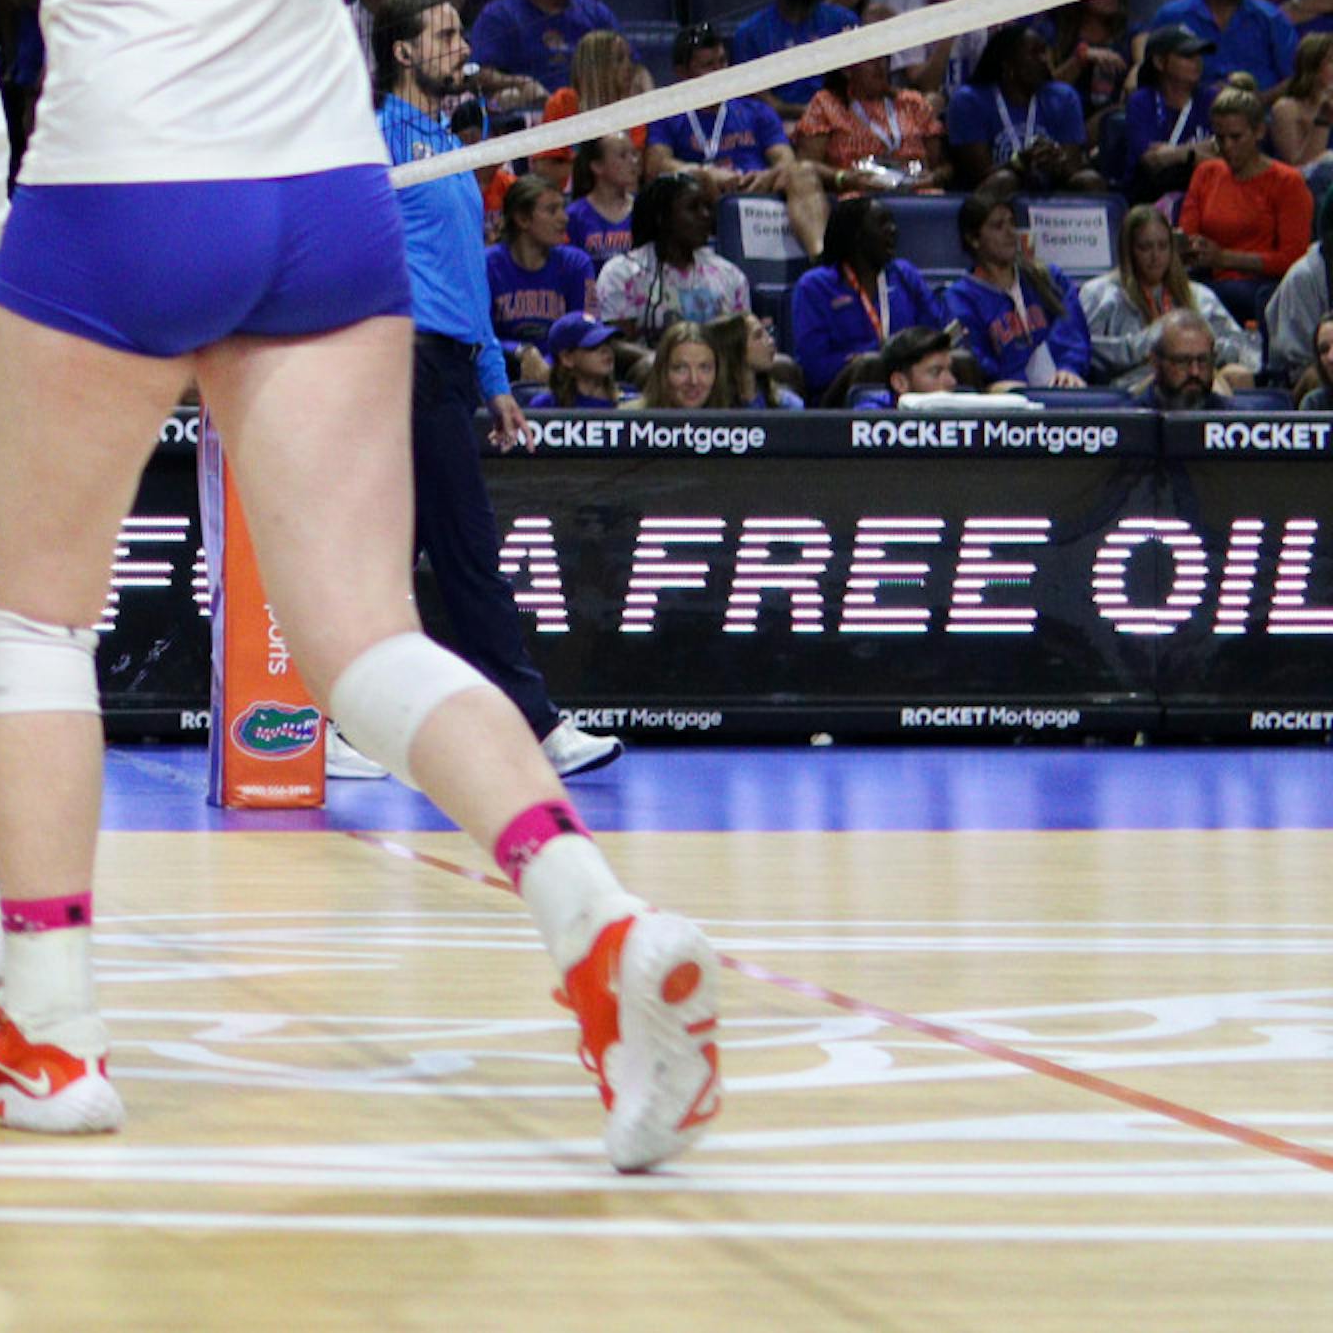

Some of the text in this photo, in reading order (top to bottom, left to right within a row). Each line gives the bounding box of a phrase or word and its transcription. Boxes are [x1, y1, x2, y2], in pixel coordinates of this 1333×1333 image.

[521, 421, 766, 453] OCKET Mortgage
[851, 421, 1119, 453] ROCKET Mortgage
[1204, 422, 1330, 450] ROCKET
[619, 517, 1052, 634] FREE
[1092, 518, 1333, 635] OIL
[559, 708, 722, 730] OCKET Mortgage
[900, 707, 1080, 729] ROCKET Mortgage
